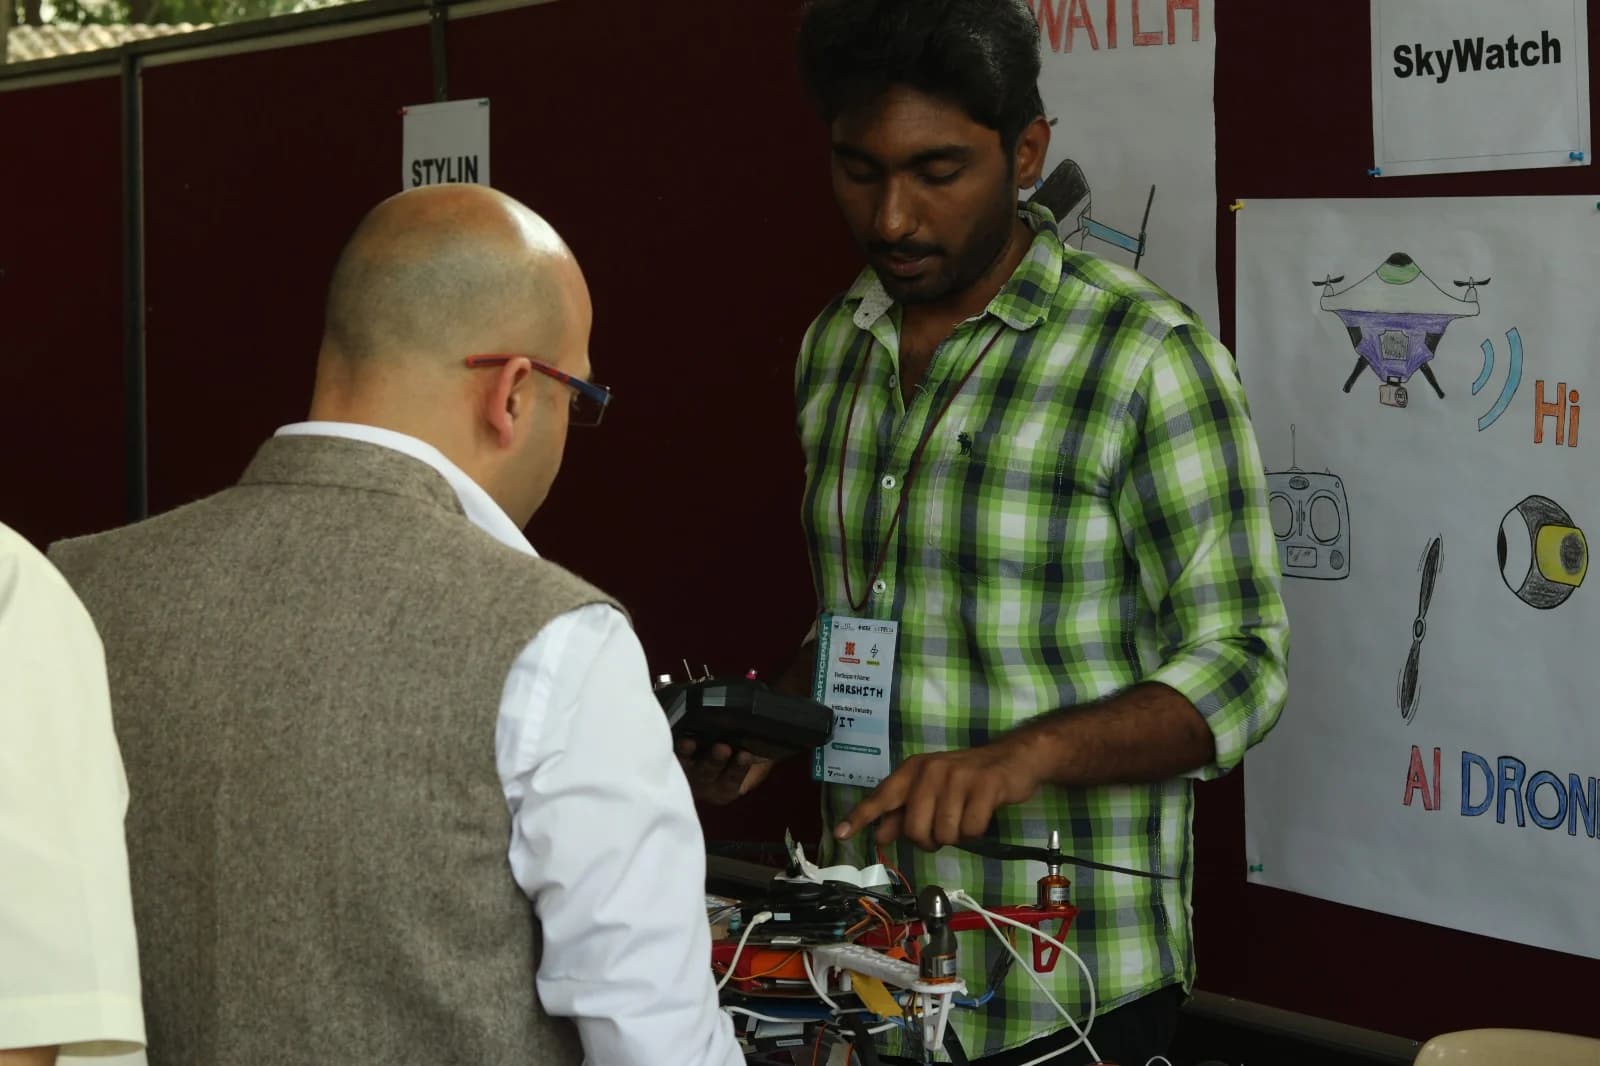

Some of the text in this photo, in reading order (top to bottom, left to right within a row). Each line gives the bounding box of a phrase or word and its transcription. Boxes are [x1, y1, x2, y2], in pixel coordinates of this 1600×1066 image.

[1393, 30, 1562, 84] SkyWatch
[412, 155, 479, 187] STYLIN
[1534, 380, 1580, 447] Hi
[832, 683, 883, 698] HARSHITH
[1403, 745, 1600, 839] AI DRON
